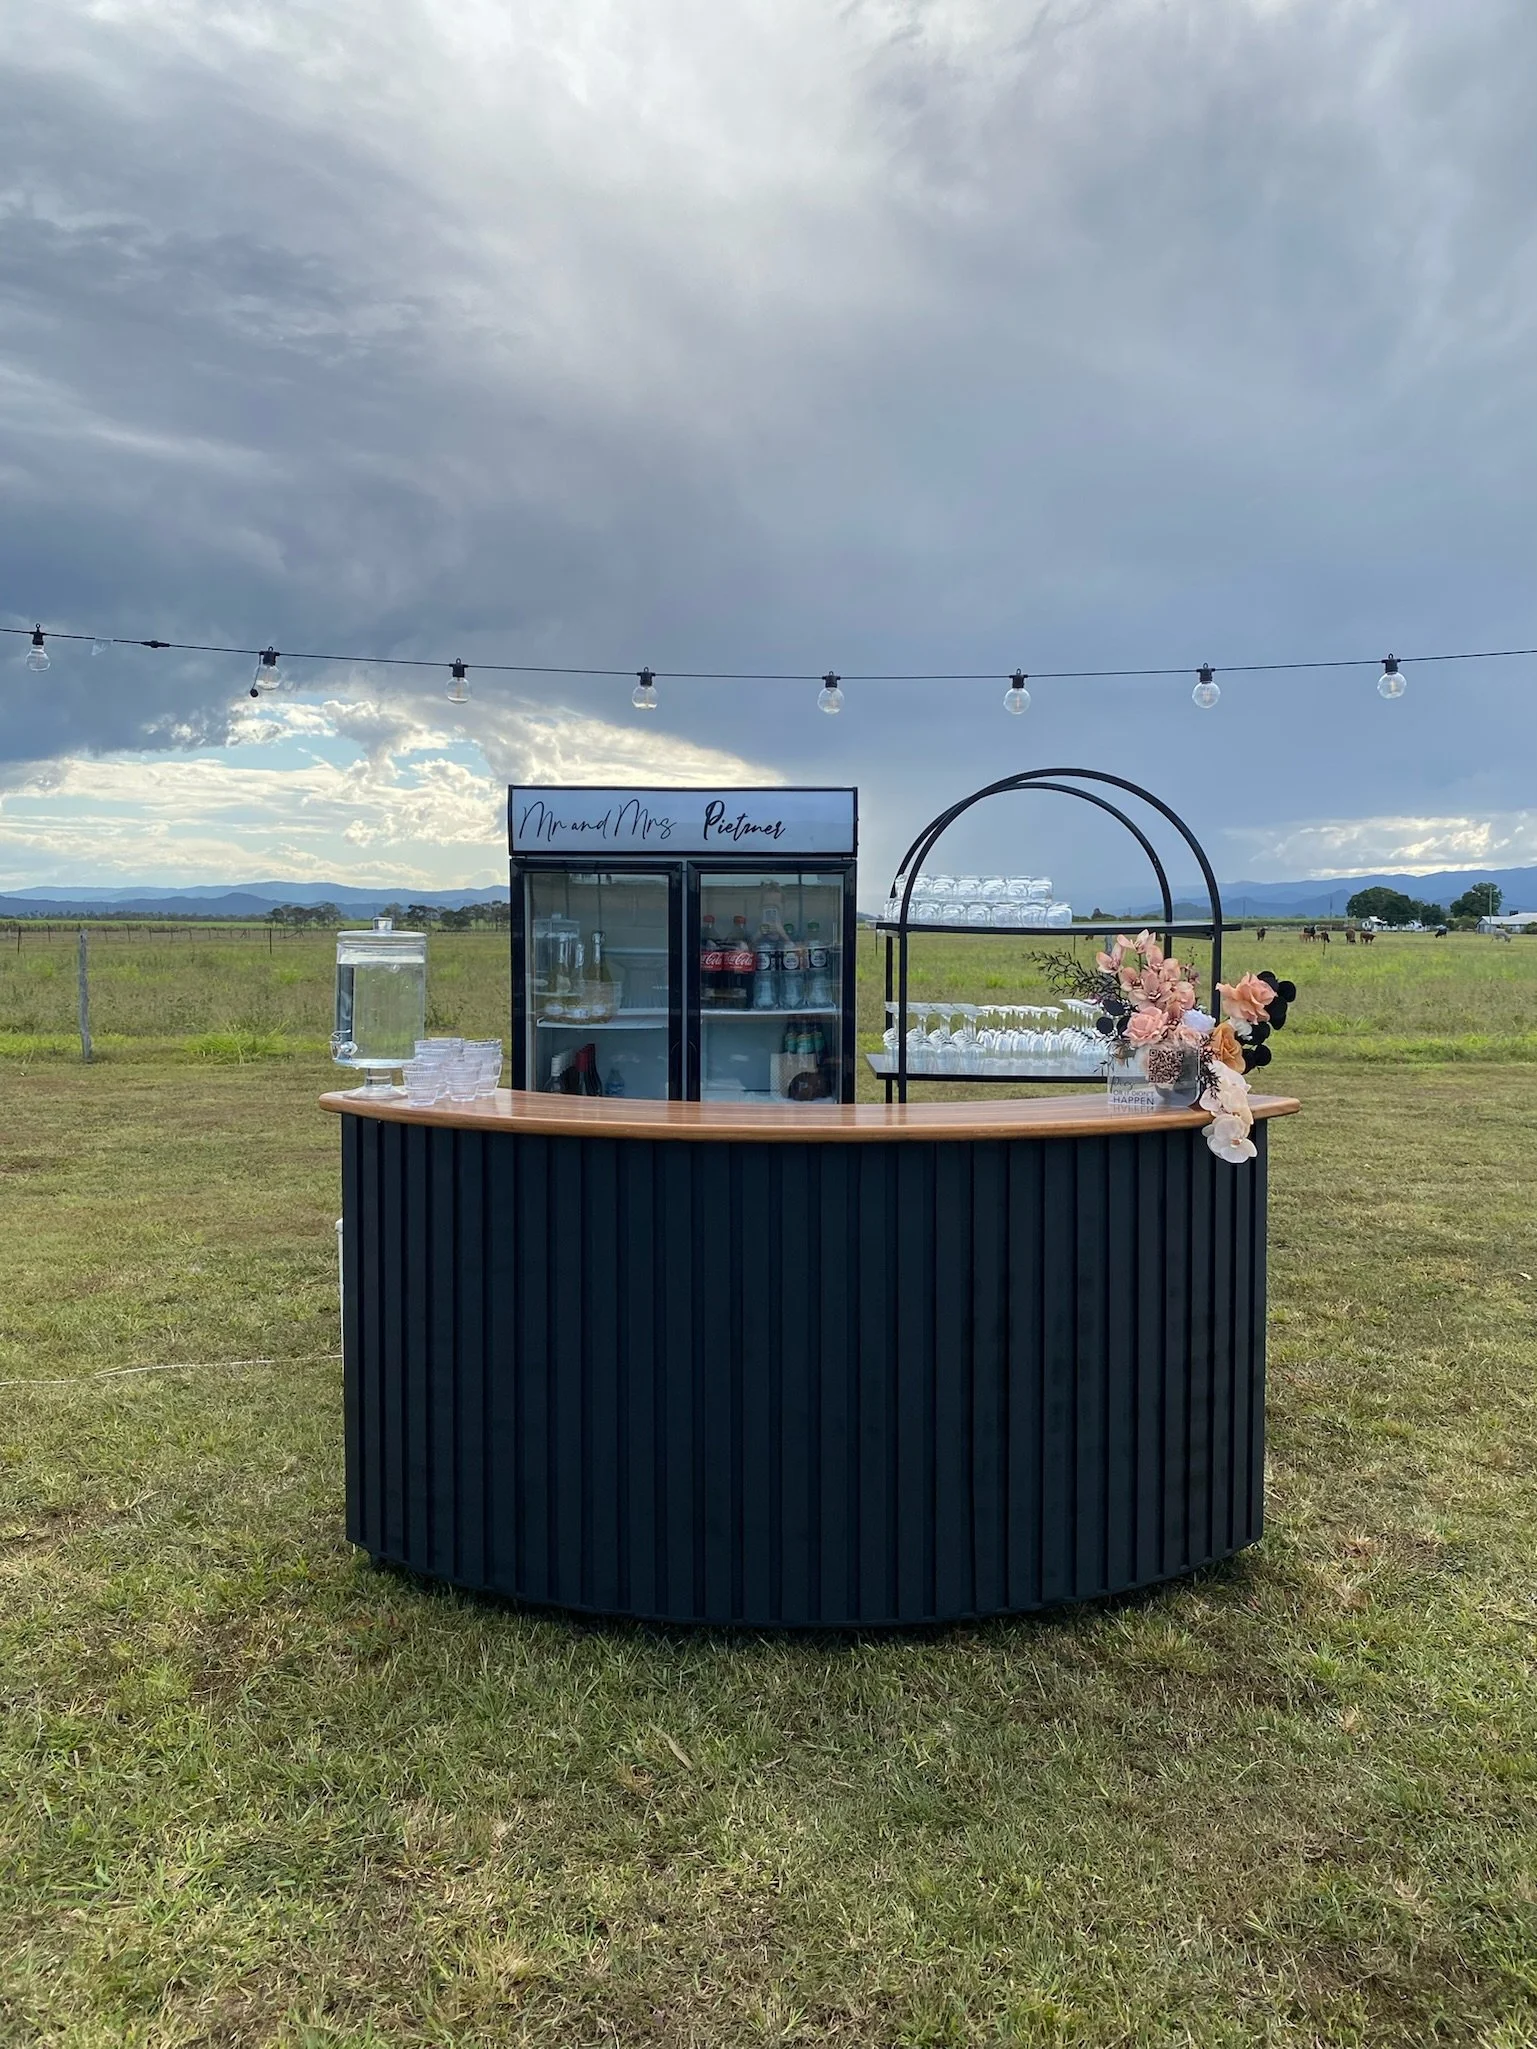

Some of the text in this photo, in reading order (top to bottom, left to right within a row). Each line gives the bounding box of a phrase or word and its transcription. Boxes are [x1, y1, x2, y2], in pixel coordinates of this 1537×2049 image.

[519, 800, 567, 841] Mr
[571, 809, 612, 840] and
[614, 799, 677, 840] Mrs
[1113, 1096, 1154, 1105] HAPPEN
